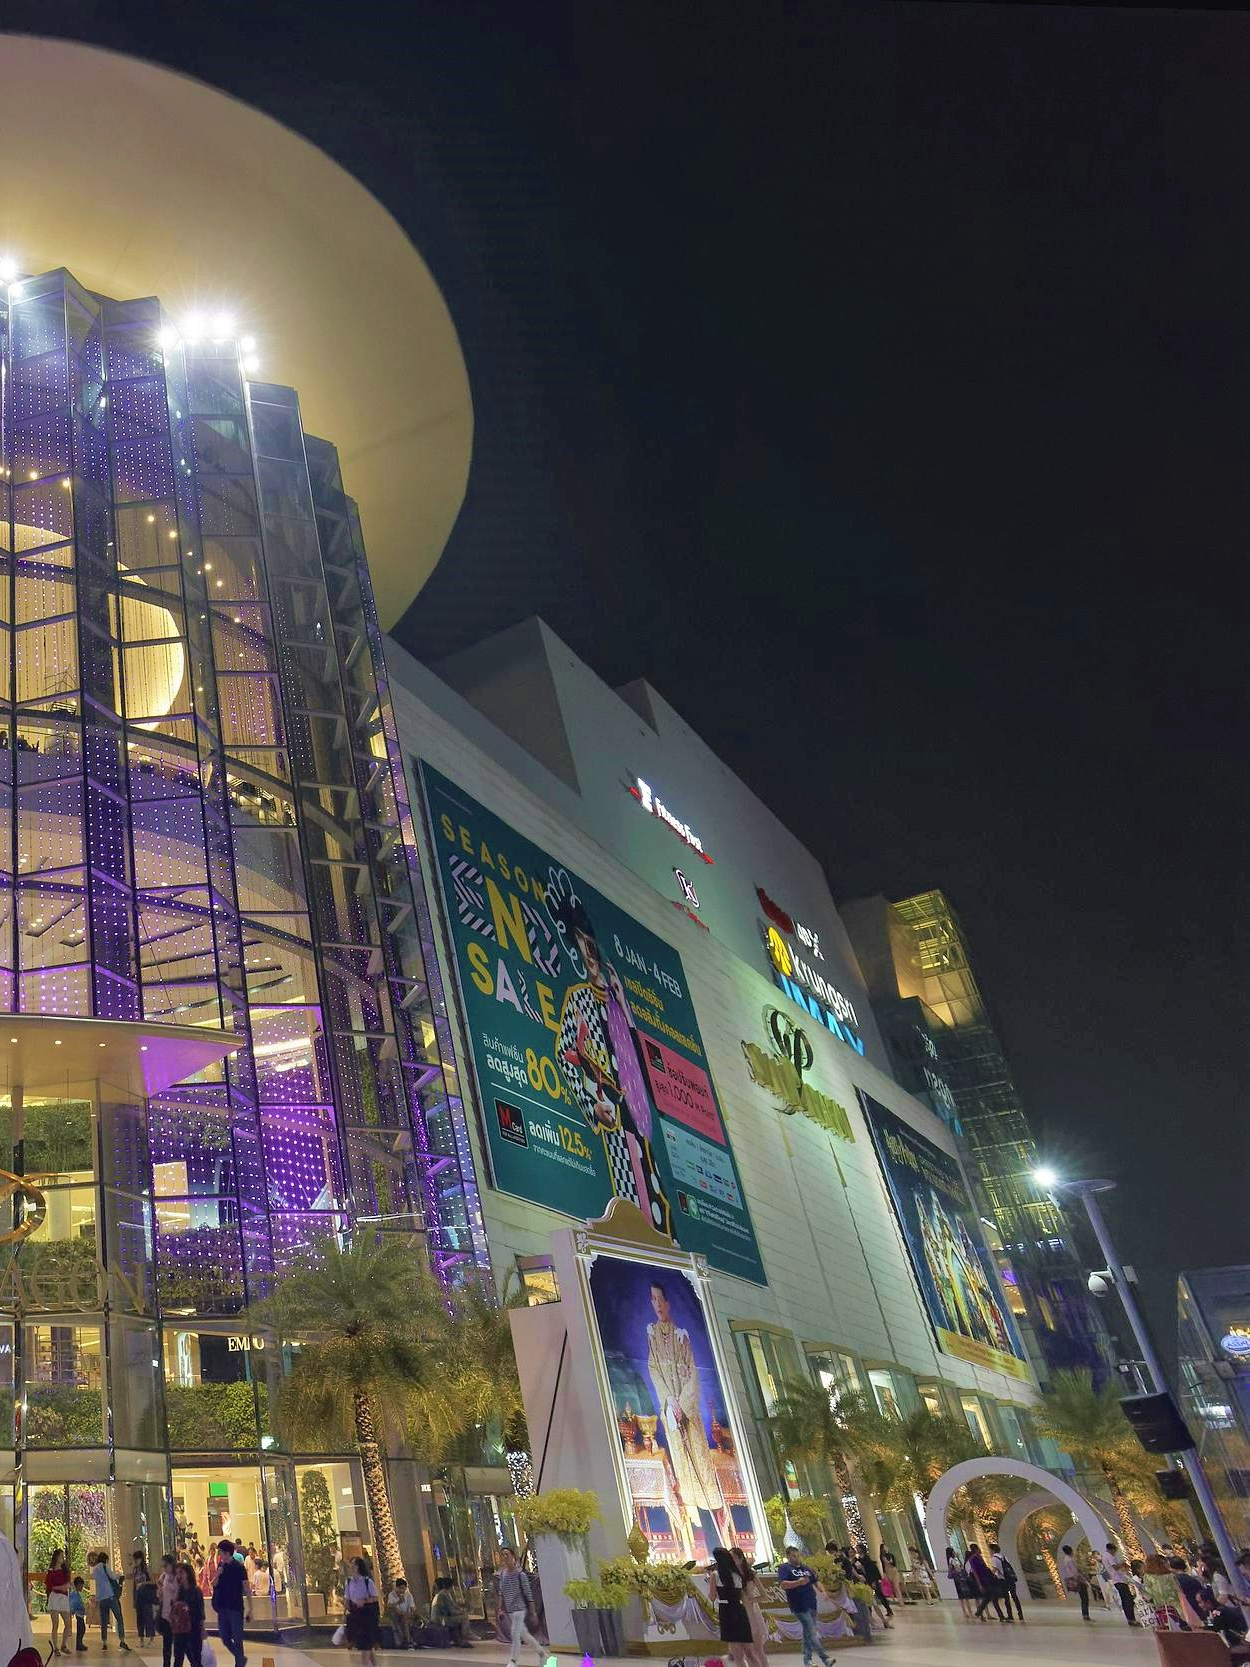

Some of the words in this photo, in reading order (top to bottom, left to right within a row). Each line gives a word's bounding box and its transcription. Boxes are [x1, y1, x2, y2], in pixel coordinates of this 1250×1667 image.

[441, 813, 547, 906] SEASON
[449, 854, 561, 978] END
[467, 942, 562, 1033] SALE
[613, 933, 624, 958] 8
[625, 945, 648, 975] JAN
[653, 962, 662, 985] 4
[661, 970, 683, 999] FEB
[486, 1054, 528, 1088] ลดสูงสุด
